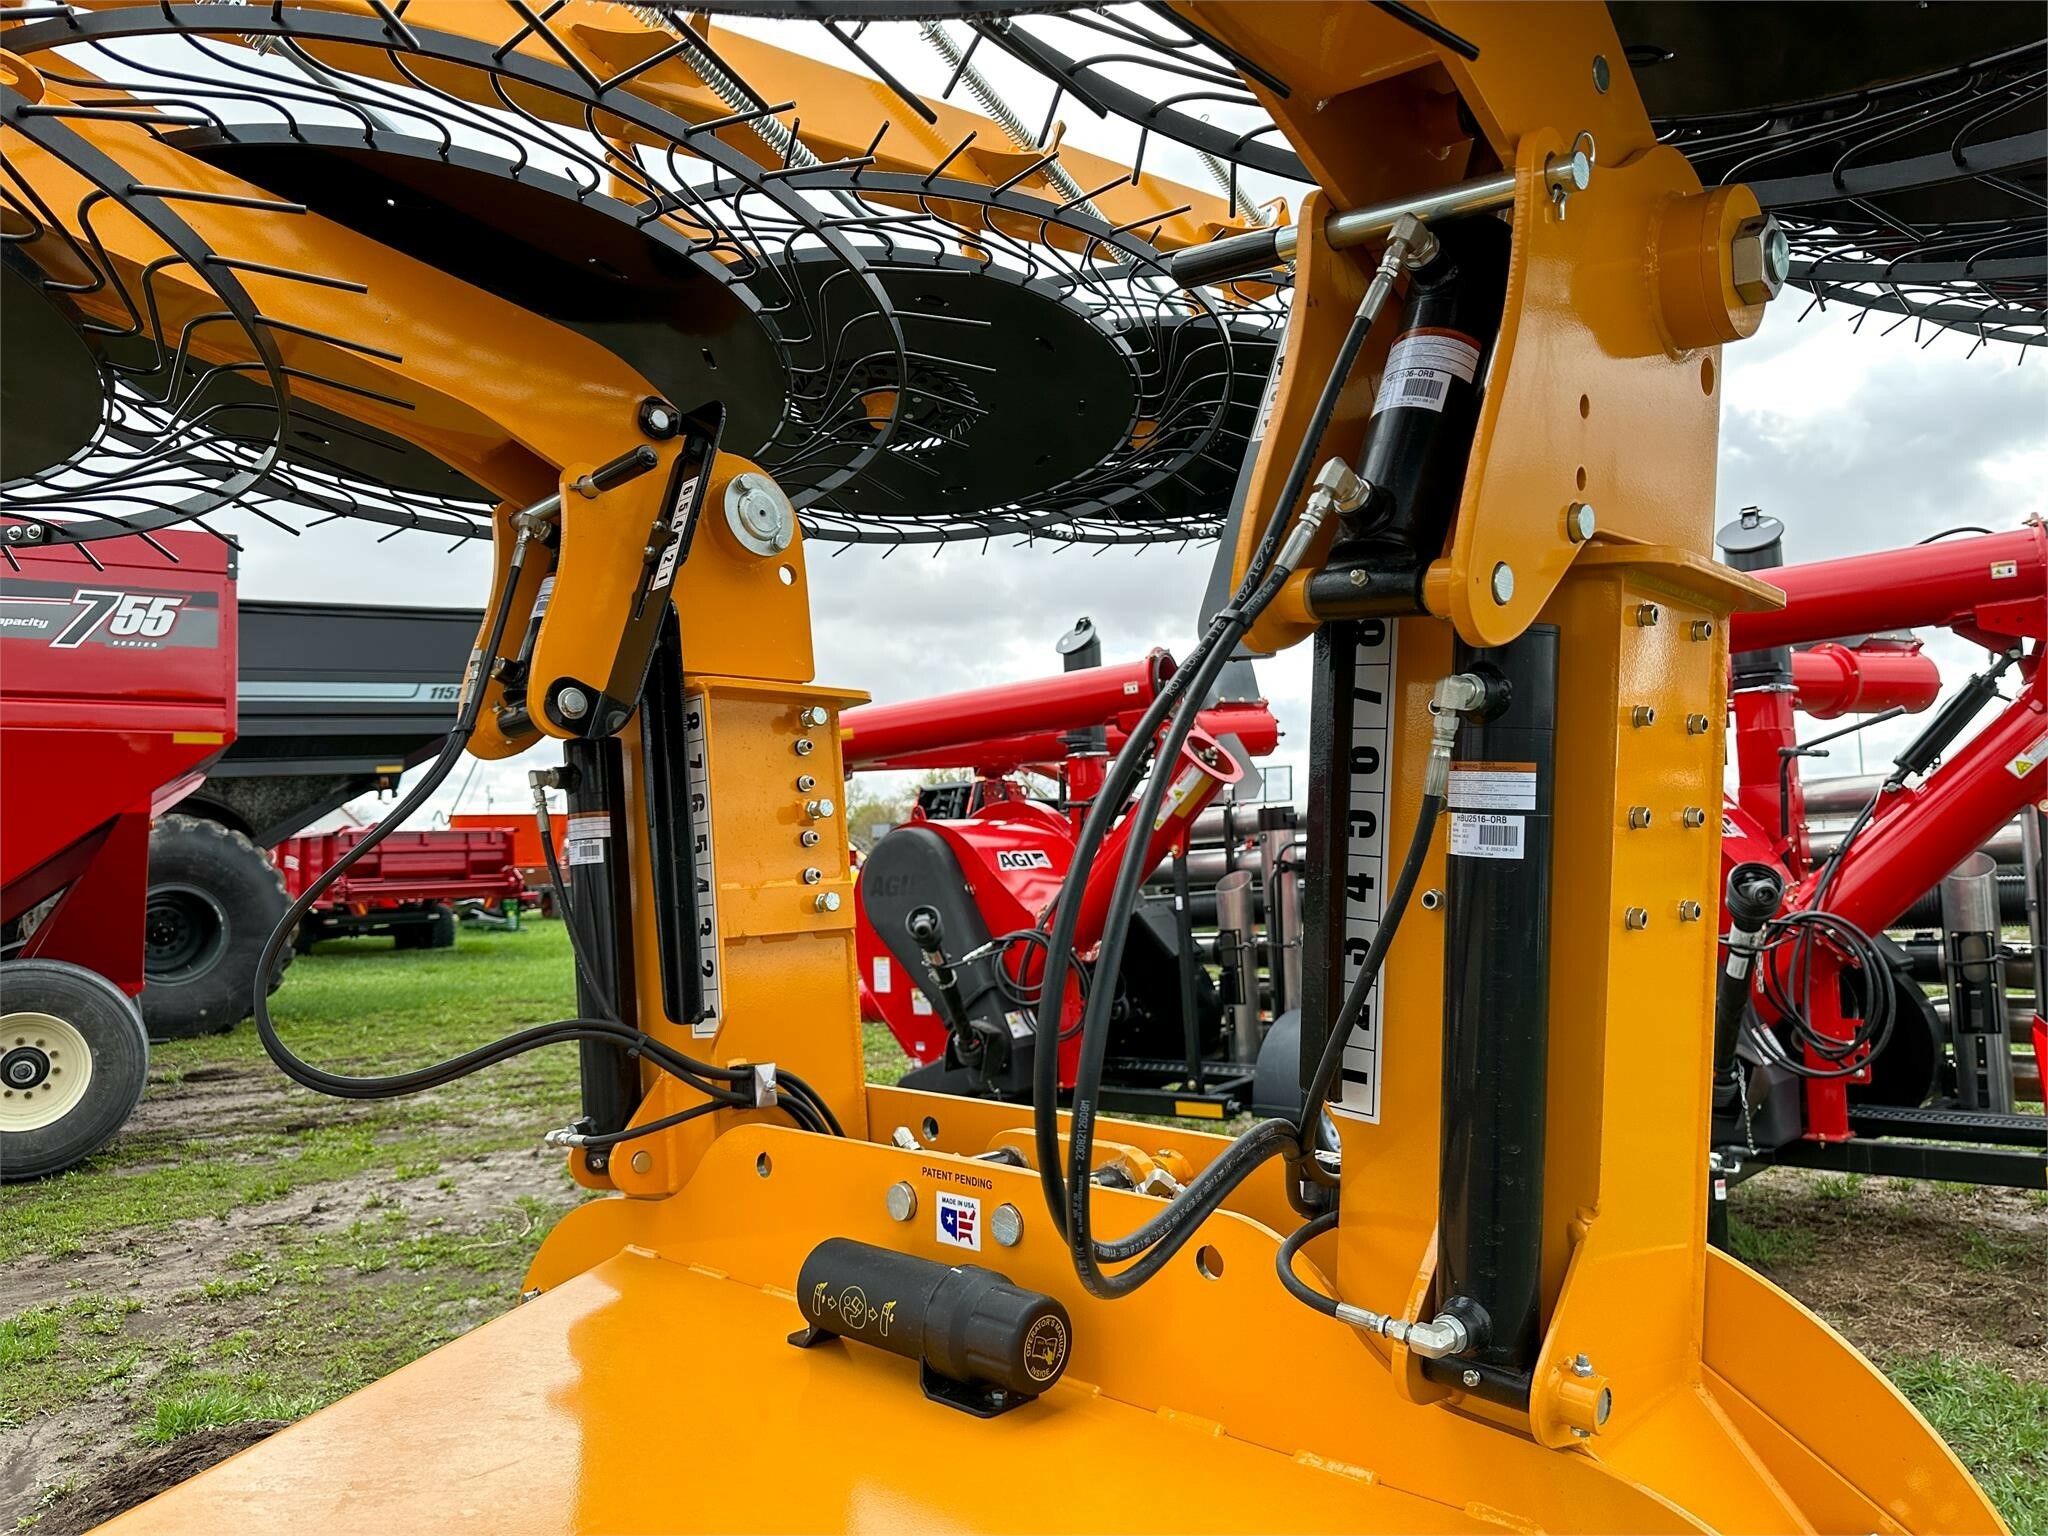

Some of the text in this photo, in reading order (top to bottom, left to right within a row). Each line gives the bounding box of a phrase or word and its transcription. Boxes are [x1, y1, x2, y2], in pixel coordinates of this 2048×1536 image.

[679, 501, 688, 512] 5
[664, 554, 673, 565] 2
[659, 573, 668, 581] 1
[49, 589, 184, 648] 755
[690, 754, 702, 769] 7
[1457, 814, 1507, 824] HBU2516-ORB
[1001, 853, 1033, 868] AGI
[922, 1166, 993, 1190] PATENT PENDING
[941, 1196, 956, 1206] MADE
[957, 1199, 963, 1207] IN
[1054, 1322, 1064, 1359] MANUAL
[1031, 1366, 1050, 1378] INSIDE
